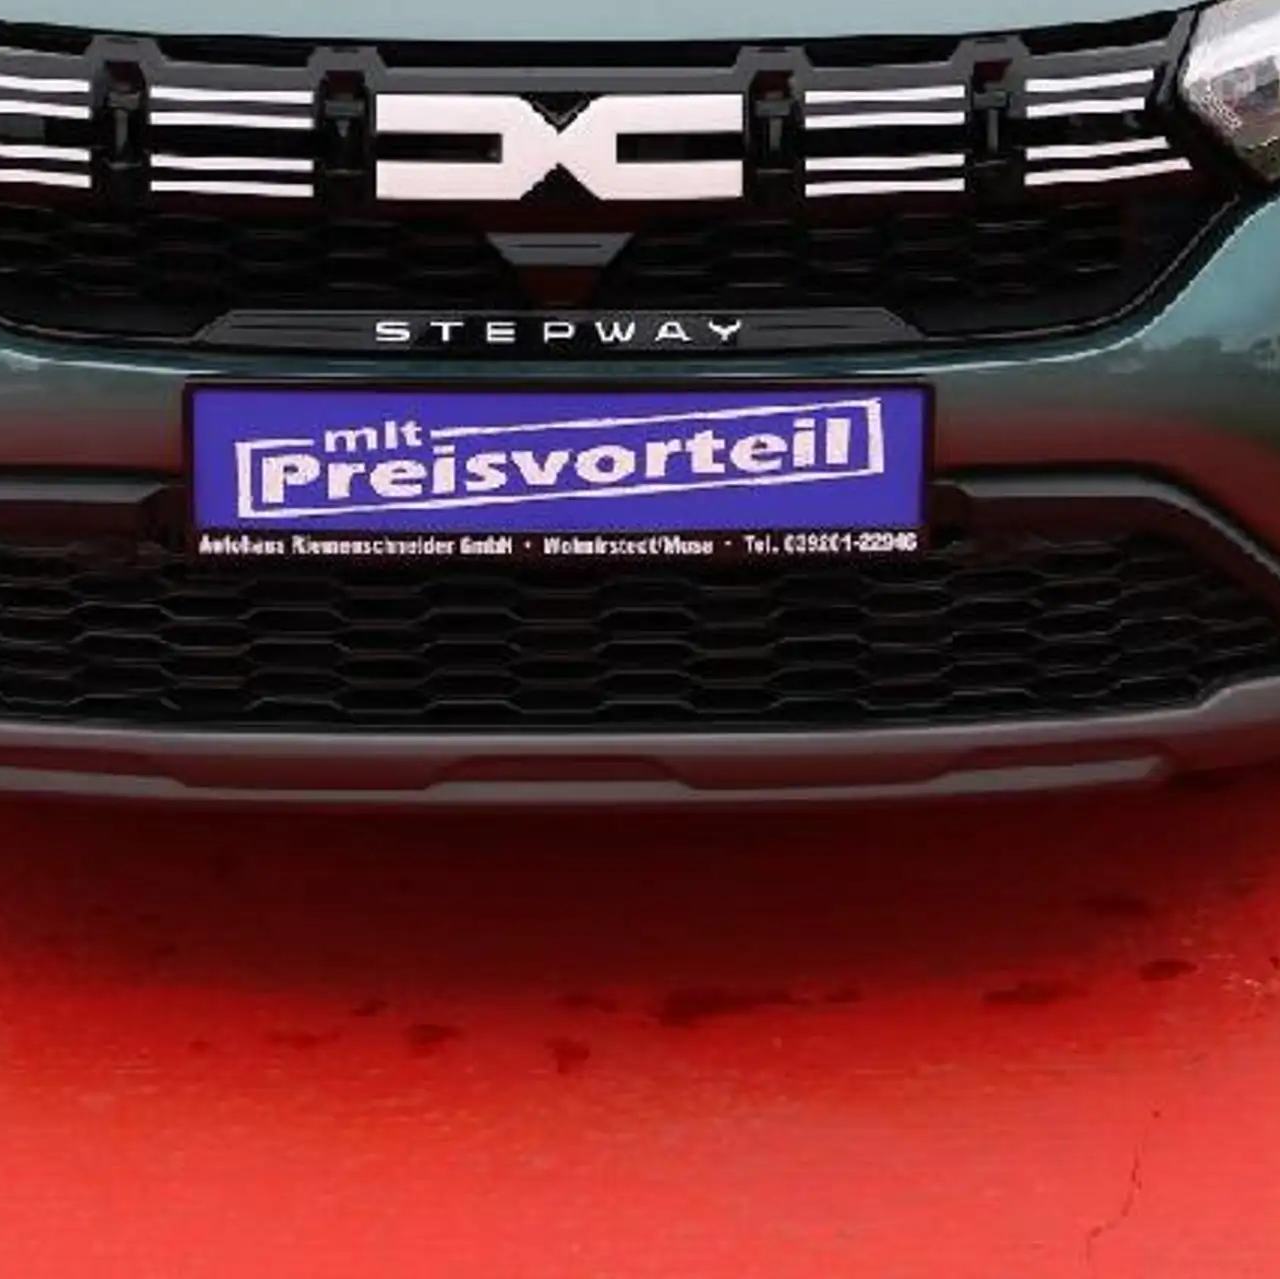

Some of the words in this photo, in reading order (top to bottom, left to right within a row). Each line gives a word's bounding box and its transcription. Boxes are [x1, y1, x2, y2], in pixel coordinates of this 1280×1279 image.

[375, 320, 742, 344] STEPWAY
[260, 418, 852, 504] Preisvorteil
[199, 534, 285, 555] Autohaus
[292, 535, 455, 555] Riemenschneider
[460, 535, 513, 555] GmbH
[744, 534, 780, 554] Tel.
